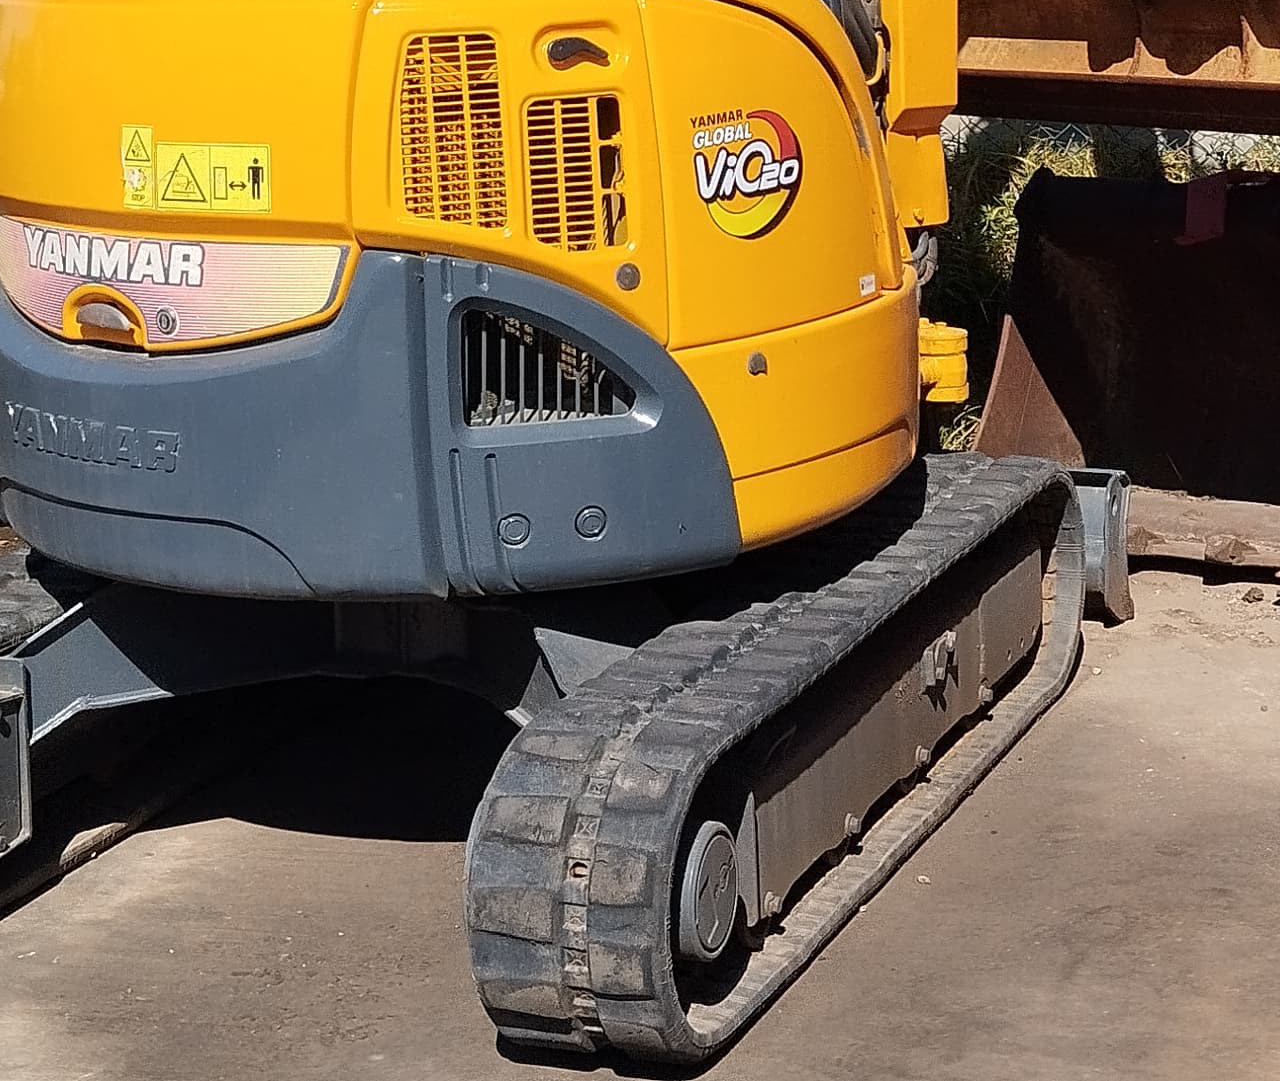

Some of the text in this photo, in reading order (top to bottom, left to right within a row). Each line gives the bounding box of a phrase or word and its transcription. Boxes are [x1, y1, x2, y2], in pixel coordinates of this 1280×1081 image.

[689, 108, 744, 129] YANMAR
[692, 120, 753, 150] GLOBAL
[23, 224, 205, 287] YANMAR
[4, 400, 181, 474] YANMAR
